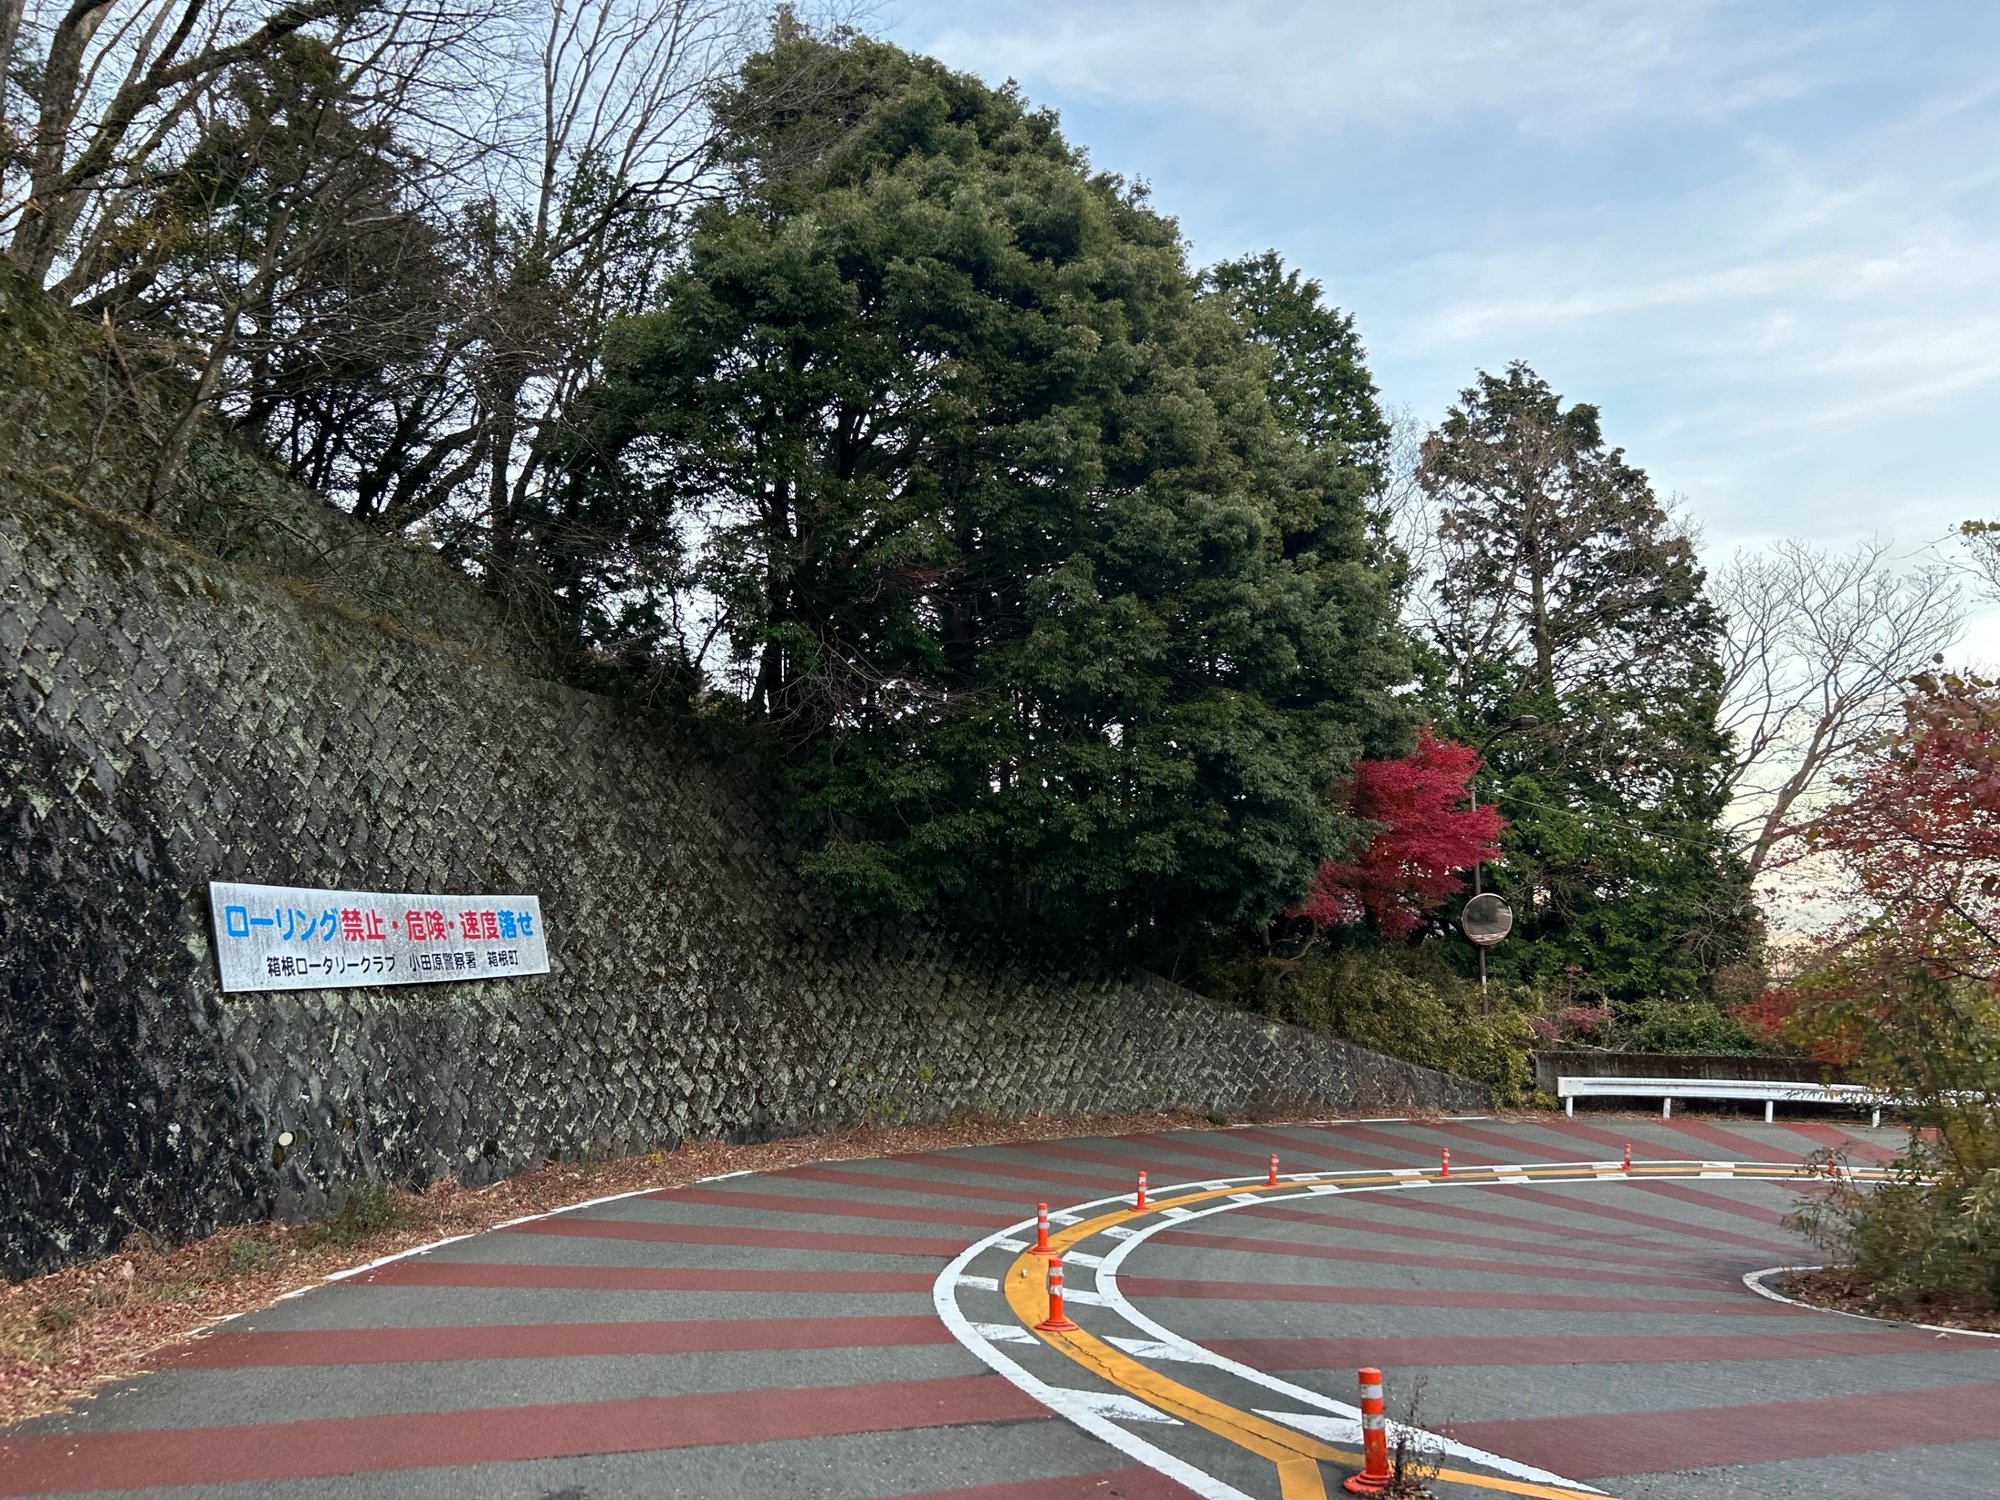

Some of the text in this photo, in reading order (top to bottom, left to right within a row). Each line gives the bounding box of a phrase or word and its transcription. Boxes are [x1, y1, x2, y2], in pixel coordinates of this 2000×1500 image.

[409, 952, 477, 971] 小田原警察署
[487, 950, 519, 968] 箱根町
